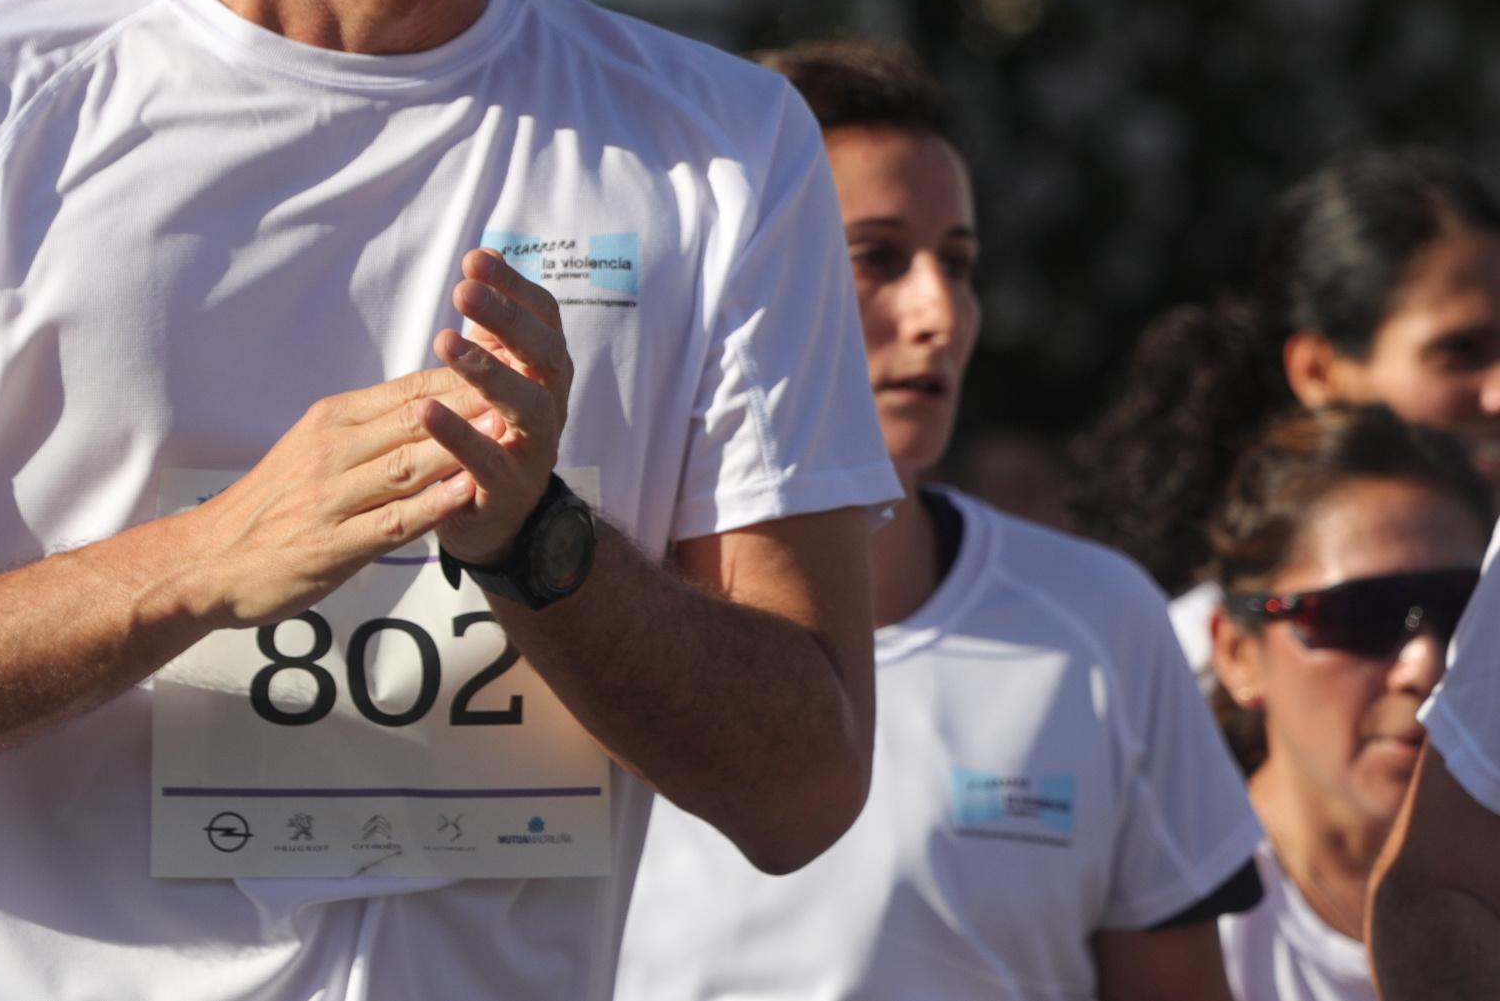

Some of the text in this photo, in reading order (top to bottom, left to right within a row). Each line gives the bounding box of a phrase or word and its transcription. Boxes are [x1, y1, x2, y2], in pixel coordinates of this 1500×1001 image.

[542, 256, 632, 271] la violencia
[249, 609, 523, 728] 802
